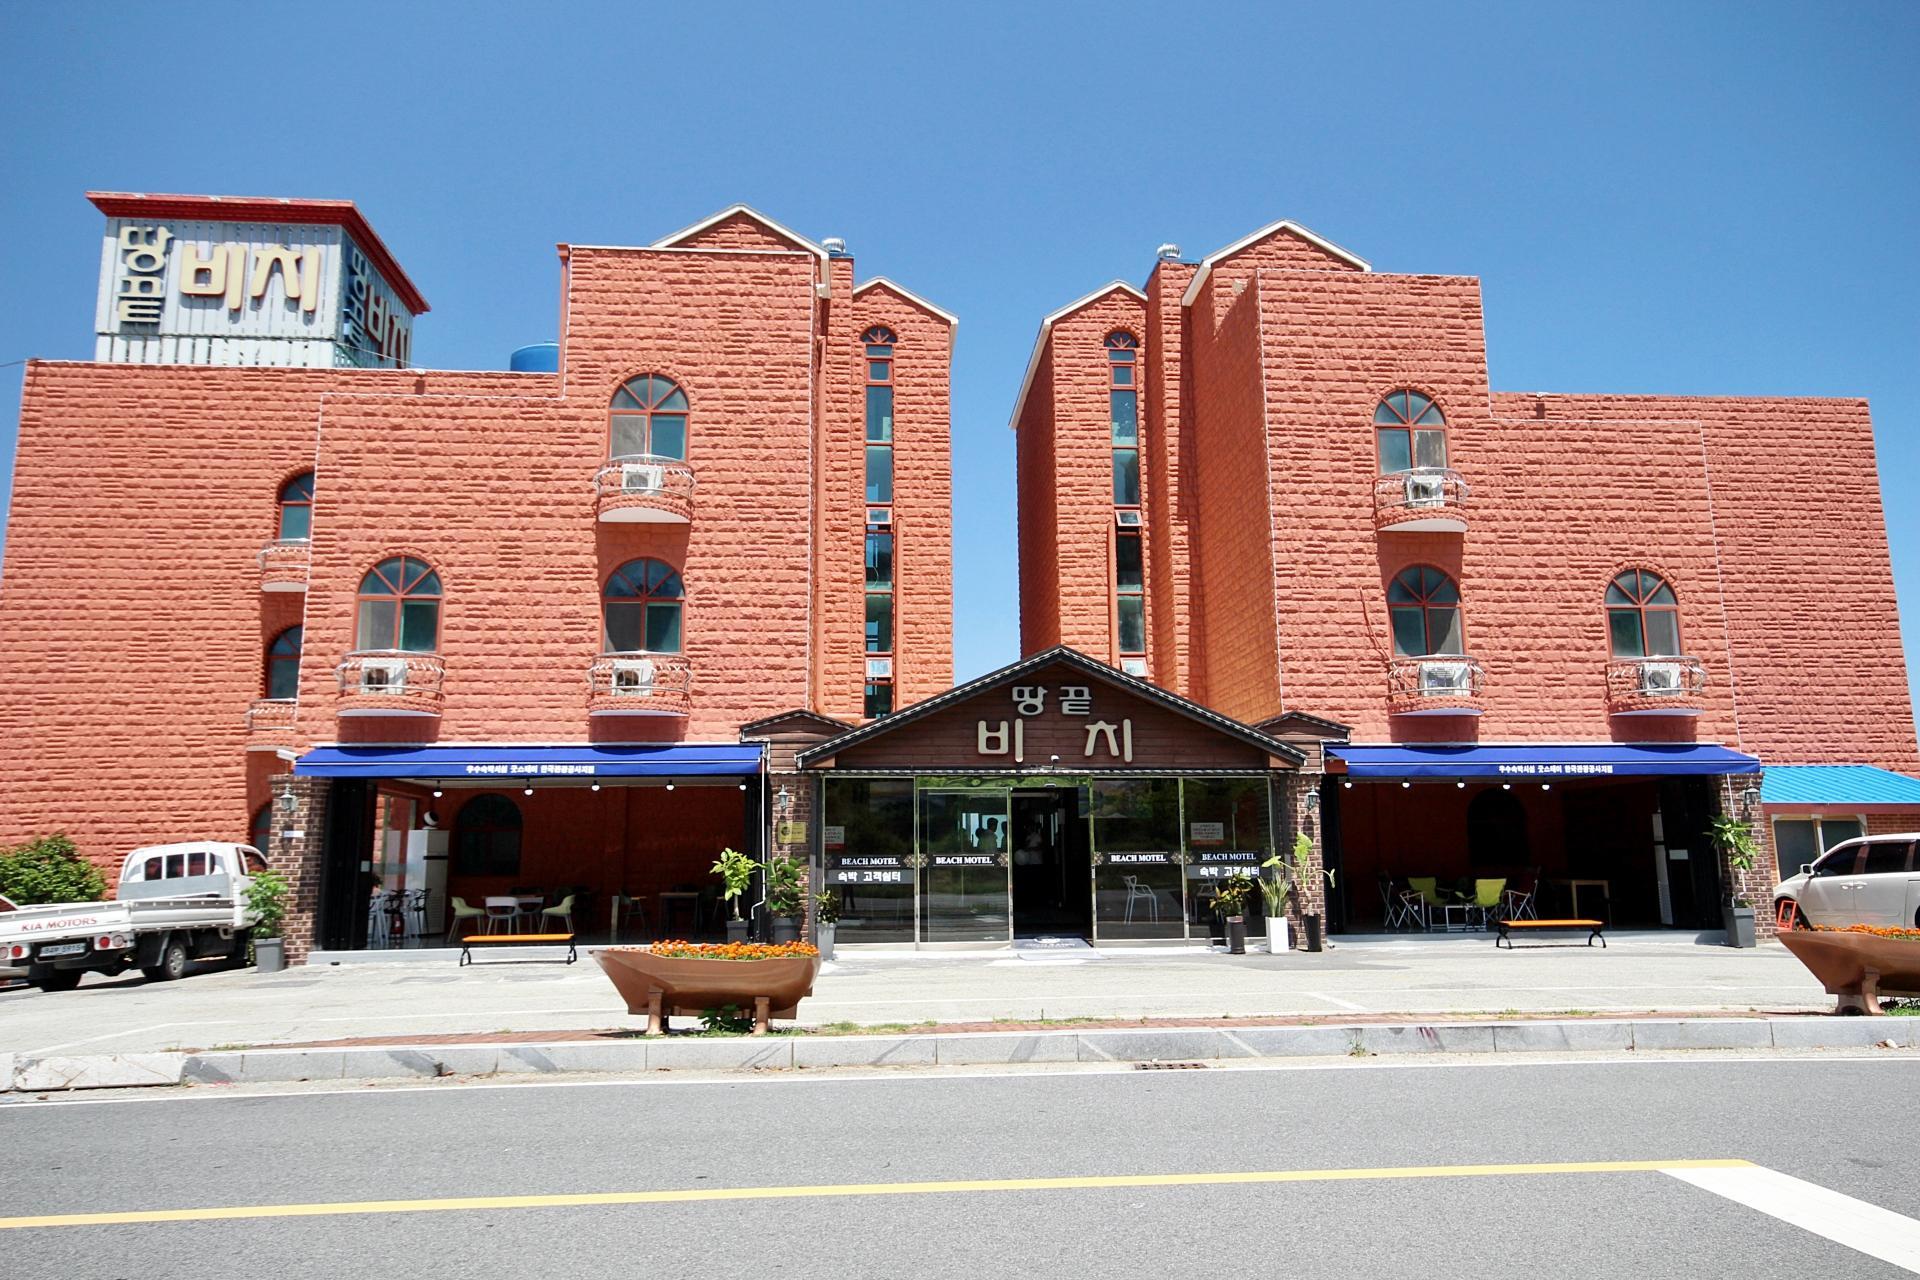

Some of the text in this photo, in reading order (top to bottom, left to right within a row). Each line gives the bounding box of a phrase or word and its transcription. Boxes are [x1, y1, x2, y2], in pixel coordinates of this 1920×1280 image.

[117, 225, 175, 324] 땅끝
[180, 244, 320, 312] 비치
[841, 857, 899, 866] BEACH MOTEL
[935, 856, 993, 865] BEACH MOTEL
[1110, 854, 1167, 863] BEACH MOTEL
[1202, 852, 1257, 862] BEACH MOTEL
[838, 871, 858, 882] 숙박
[1200, 866, 1219, 877] 숙박
[21, 917, 97, 932] KIA MOTORS
